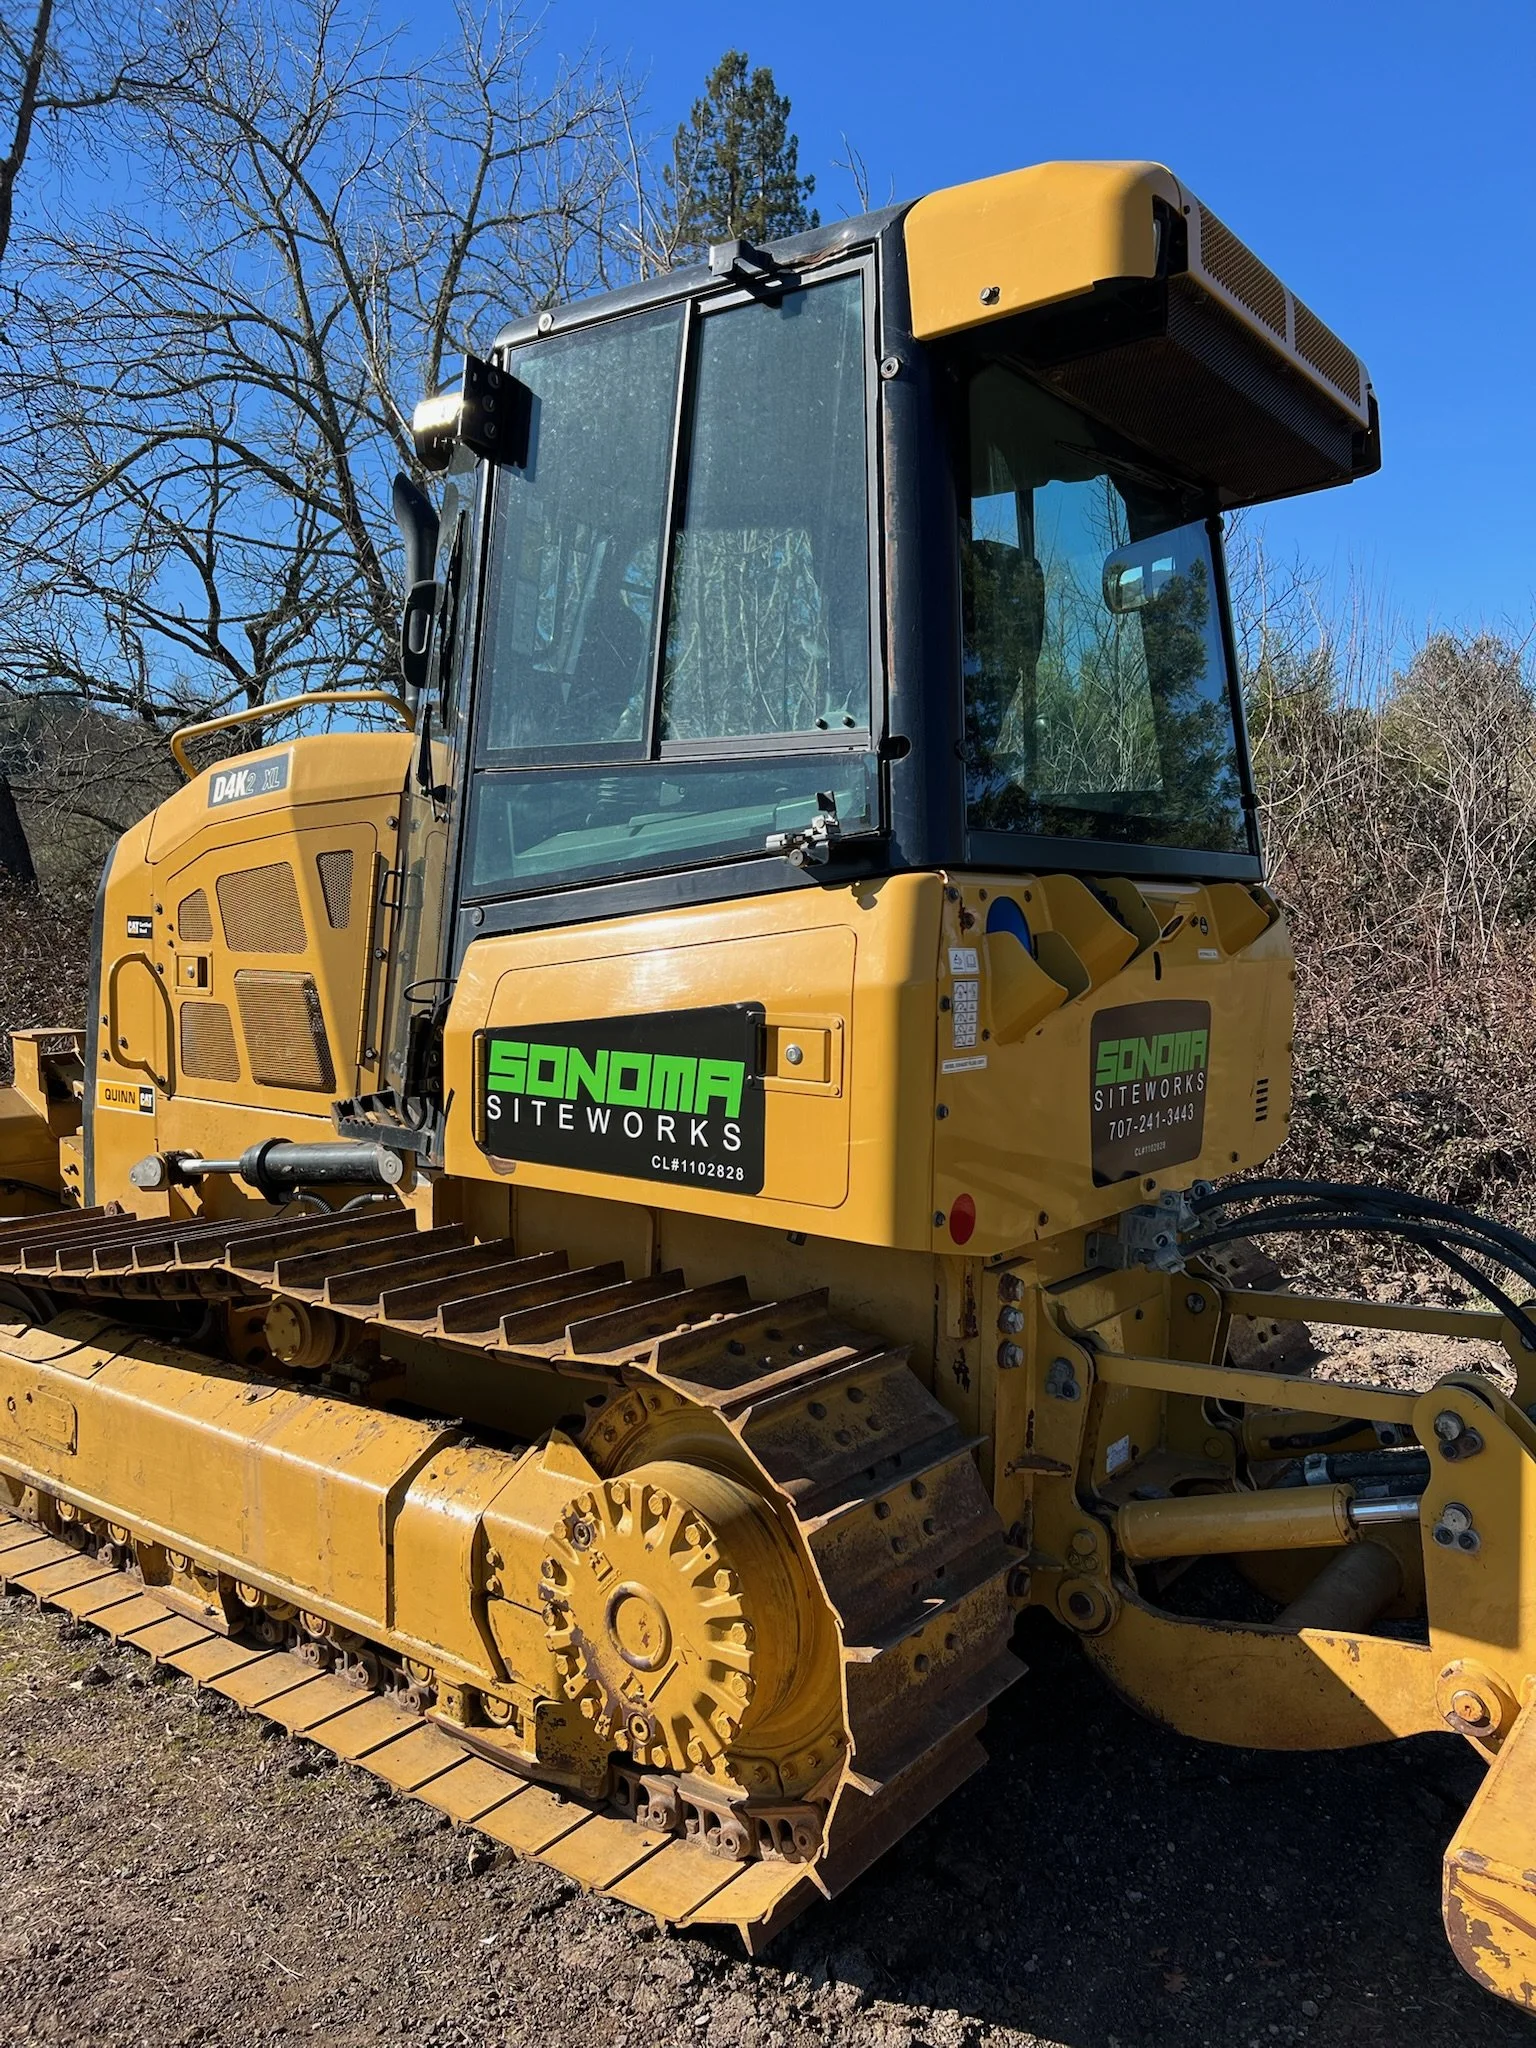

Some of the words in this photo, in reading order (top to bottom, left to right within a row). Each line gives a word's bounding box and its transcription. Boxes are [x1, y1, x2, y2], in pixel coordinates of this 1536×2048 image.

[262, 767, 279, 790] XL
[128, 920, 139, 934] CAT
[1095, 1029, 1208, 1086] SONOMA
[105, 1088, 135, 1104] QUINN
[140, 1093, 152, 1107] CAT
[488, 1040, 745, 1118] SONOMA
[1094, 1072, 1205, 1111] SITEWORKS
[487, 1094, 742, 1151] SITEWORKS
[1109, 1103, 1194, 1140] 707-241-3443
[651, 1155, 744, 1181] CL#1102828
